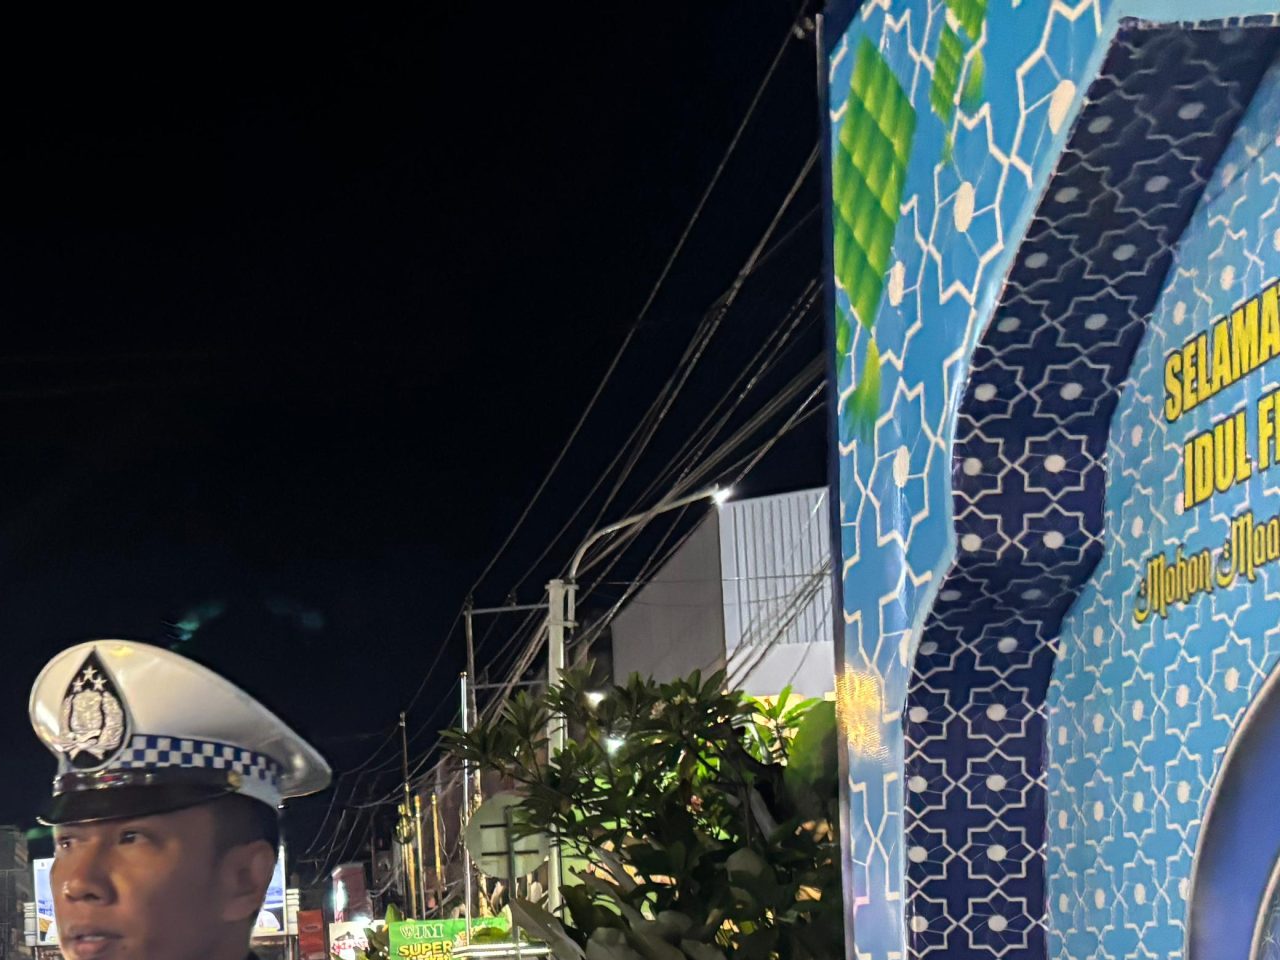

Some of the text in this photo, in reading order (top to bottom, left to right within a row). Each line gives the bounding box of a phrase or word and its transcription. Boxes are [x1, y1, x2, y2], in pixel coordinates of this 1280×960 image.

[1164, 278, 1280, 423] SELAMA
[1184, 410, 1252, 511] IDUL
[1133, 544, 1214, 623] Mohon
[399, 940, 453, 957] SUPER
